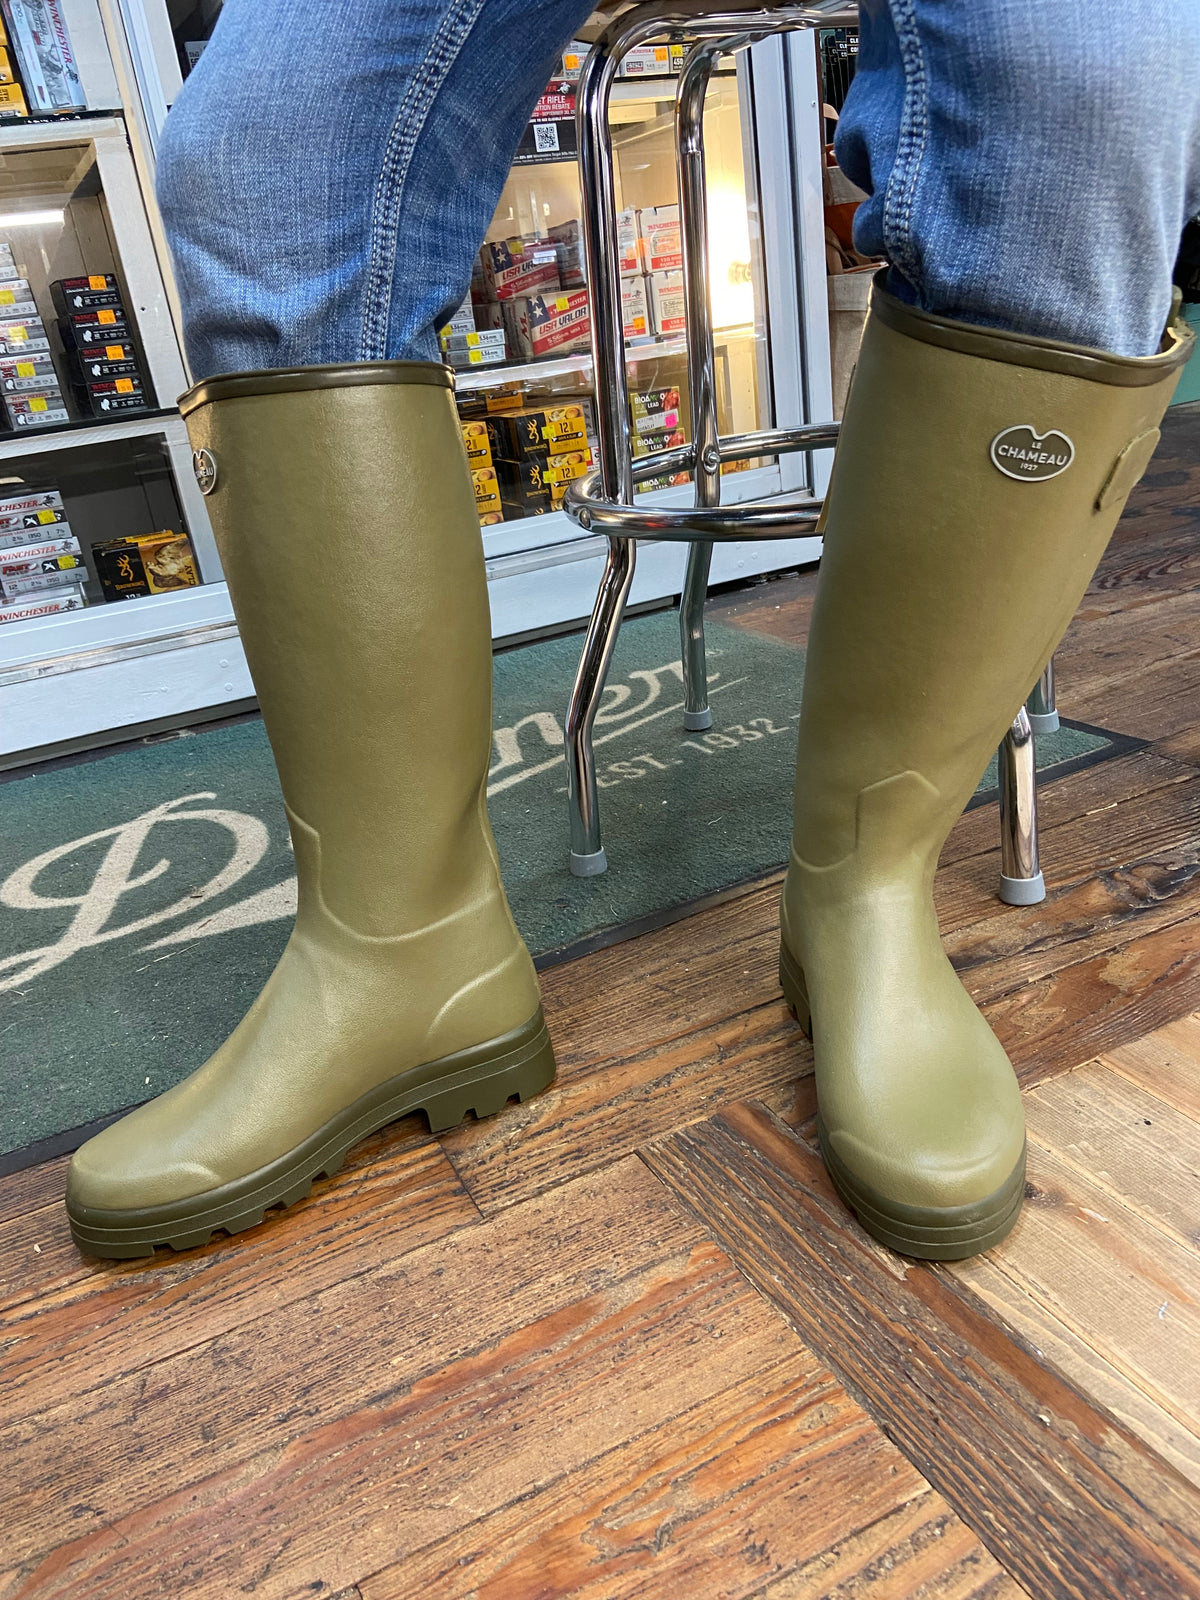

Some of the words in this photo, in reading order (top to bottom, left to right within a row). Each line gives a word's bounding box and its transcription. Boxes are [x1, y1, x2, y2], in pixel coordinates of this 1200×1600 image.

[547, 95, 566, 103] RIFLE
[539, 320, 557, 335] USA
[558, 306, 587, 326] VALOR
[559, 422, 569, 433] 12
[1032, 441, 1043, 450] LE
[997, 444, 1068, 467] CHAMEAU
[561, 467, 571, 478] 12
[1019, 462, 1039, 472] 1927
[0, 545, 57, 561] WINCHESTER
[184, 564, 197, 586] CLAY
[0, 603, 60, 620] WINCHESTER
[680, 717, 792, 755] 1932
